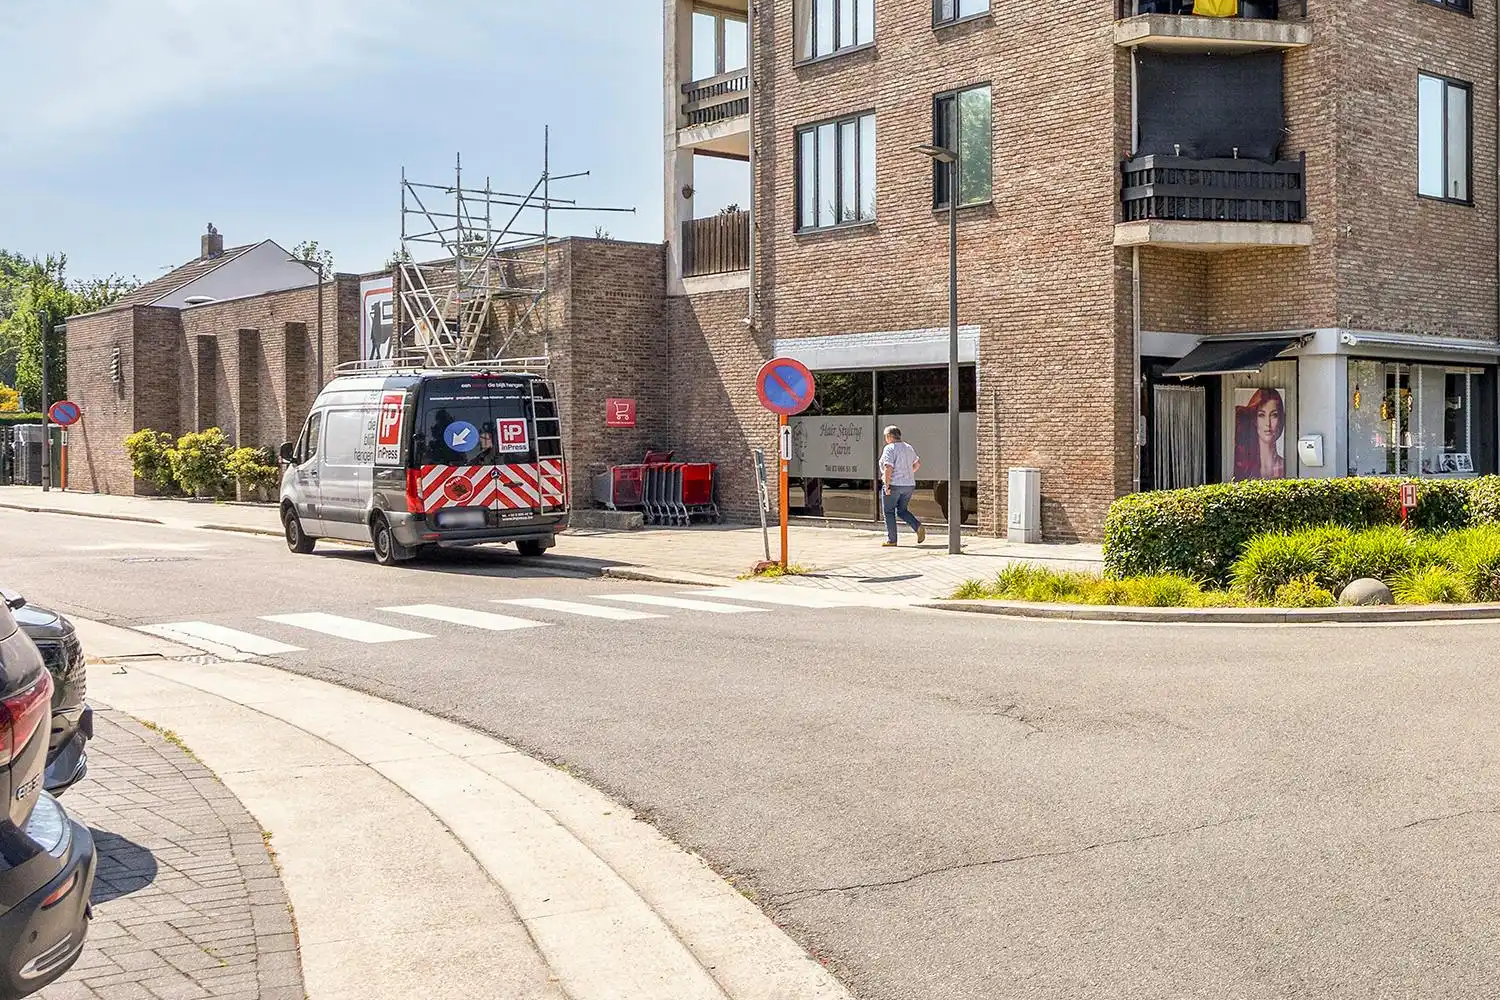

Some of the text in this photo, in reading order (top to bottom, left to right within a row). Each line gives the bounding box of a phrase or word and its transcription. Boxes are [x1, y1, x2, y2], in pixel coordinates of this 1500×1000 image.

[819, 422, 863, 441] Hair Styling
[377, 446, 398, 460] inPress
[830, 442, 851, 457] Karin
